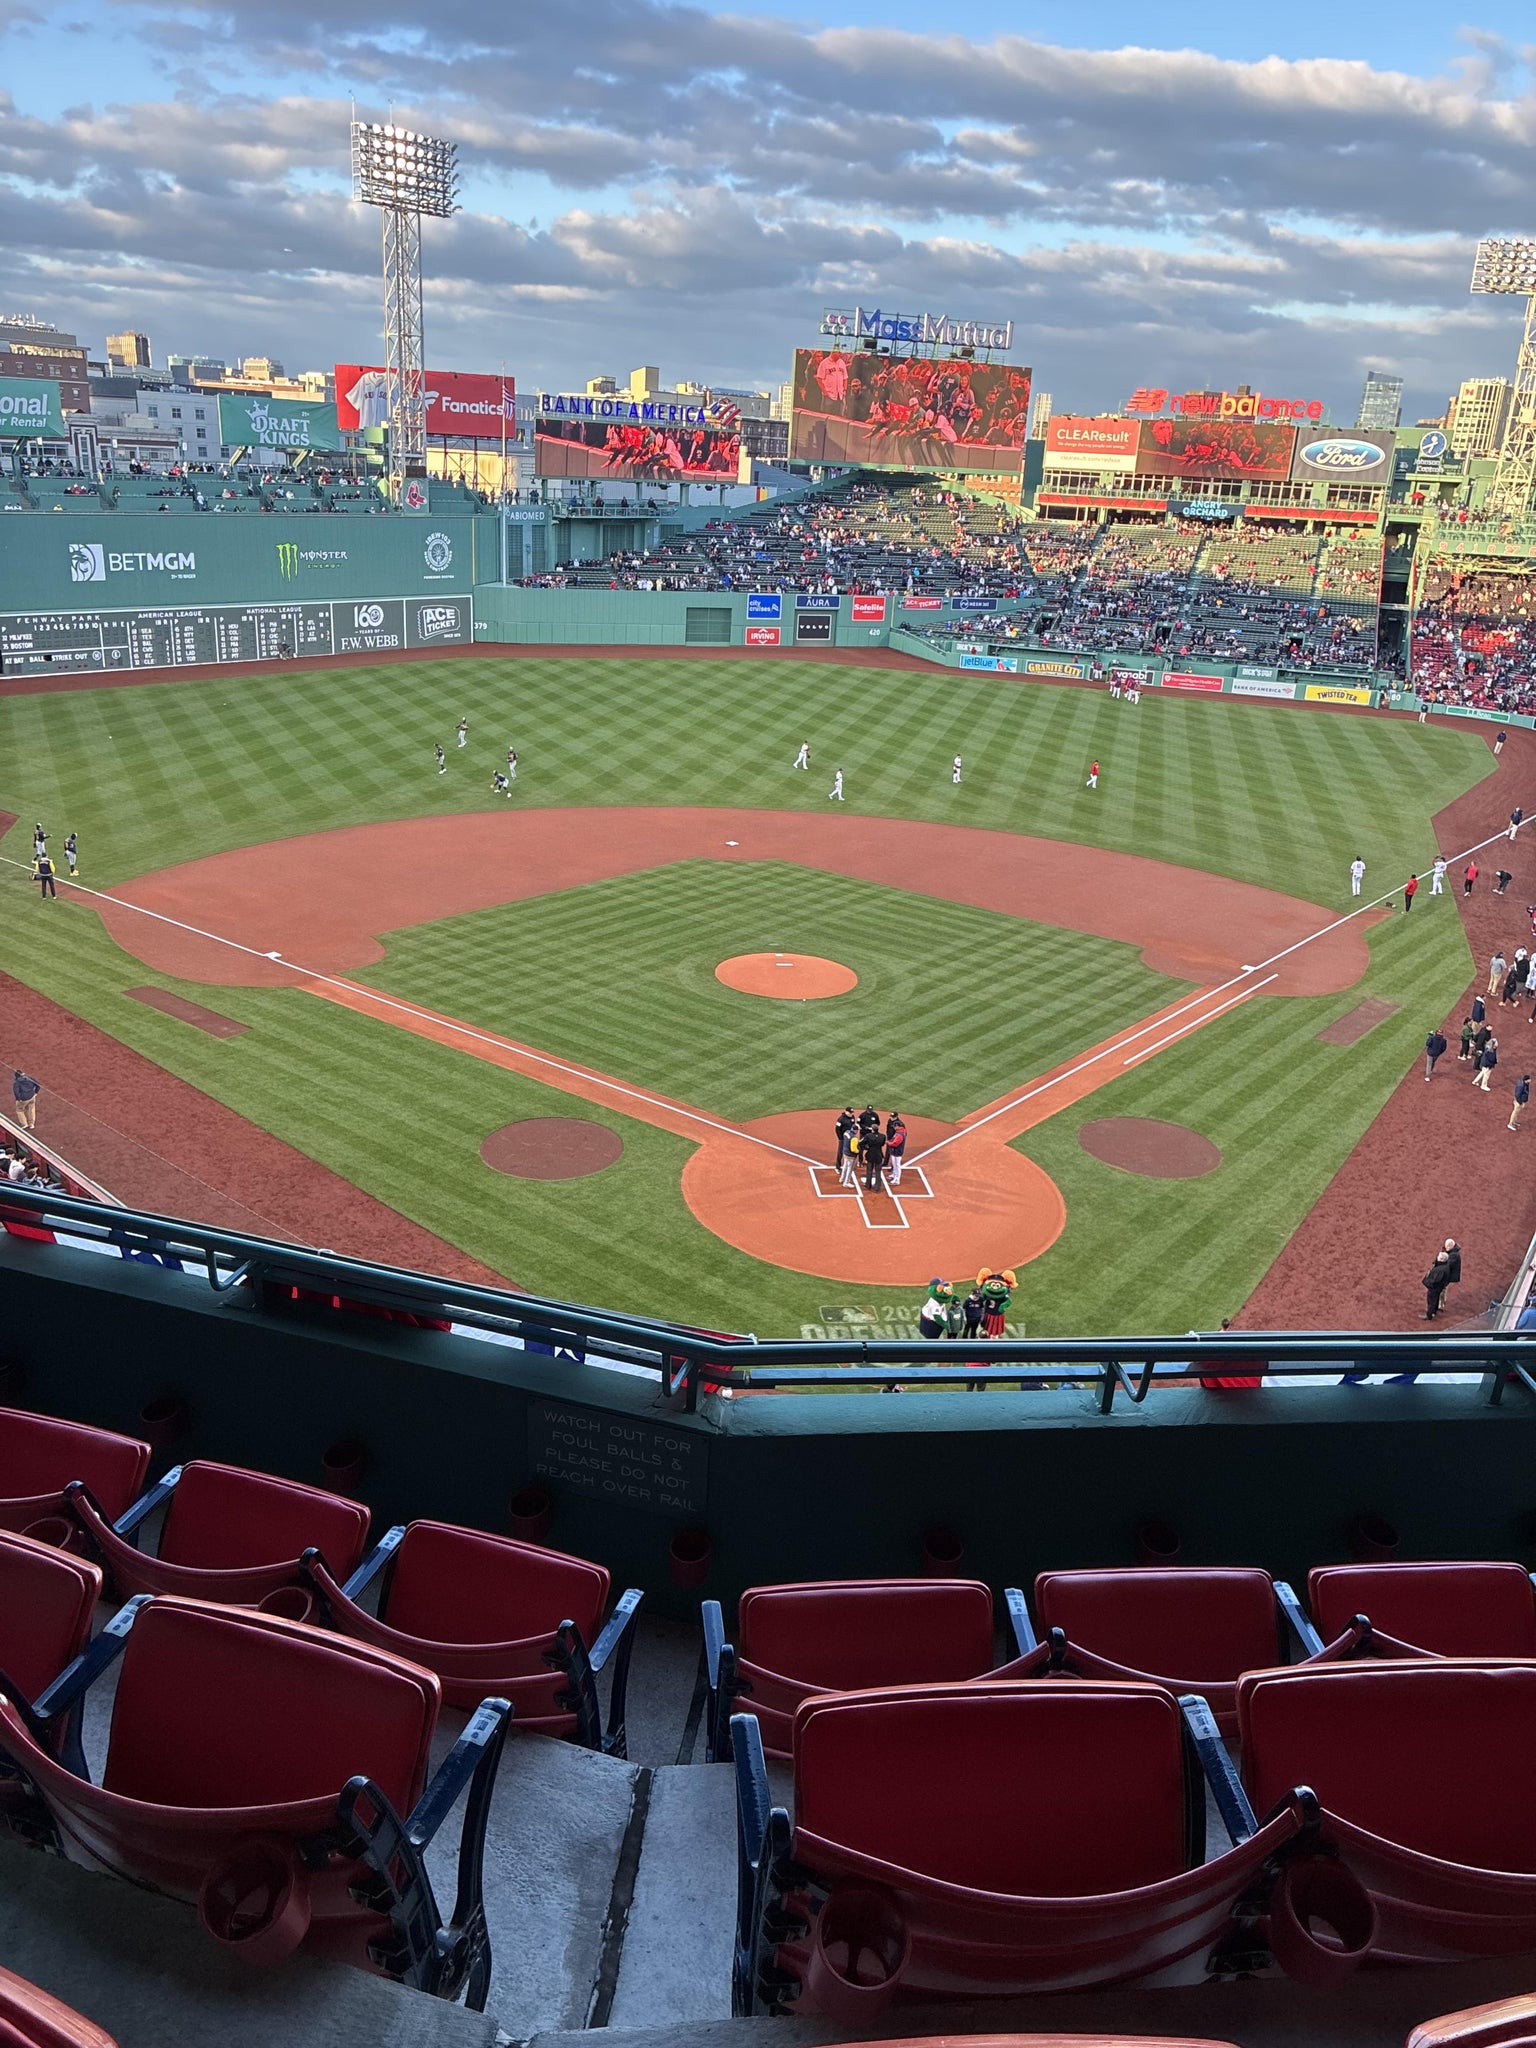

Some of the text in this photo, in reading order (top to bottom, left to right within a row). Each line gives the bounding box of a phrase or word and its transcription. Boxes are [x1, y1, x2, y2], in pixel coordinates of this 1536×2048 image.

[855, 306, 1014, 350] MassMutual
[442, 396, 504, 416] Fanatics
[542, 394, 706, 423] BANK OF AMERICA
[1171, 392, 1324, 419] new balance
[11, 417, 46, 427] Rental
[251, 415, 310, 432] DRAFT
[260, 430, 310, 446] KINGS
[1057, 429, 1129, 442] CLEAResult
[1316, 444, 1368, 466] Ford
[1183, 507, 1228, 517] ORCHARD
[1190, 500, 1222, 509] ANGRY
[510, 511, 544, 520] ABIOMED
[300, 550, 348, 560] MONSTER
[1456, 543, 1464, 552] 4
[1472, 543, 1478, 553] 1
[1504, 545, 1520, 555] 27
[108, 553, 195, 571] BETMGM
[354, 605, 384, 628] 160
[426, 608, 455, 623] ACE
[427, 620, 455, 632] TICKET
[341, 634, 398, 650] F.W. WEBB
[964, 656, 992, 667] jetBlue
[1028, 663, 1062, 672] GRANITE
[1064, 665, 1082, 676] CITY
[1346, 693, 1358, 702] TEA
[989, 1300, 996, 1309] 3
[881, 1305, 921, 1322] 202
[800, 1324, 928, 1340] OPENIN
[544, 1410, 691, 1454] WATCH OUT FOR
[552, 1431, 682, 1471] FOUL BALLS &
[546, 1448, 690, 1490] PLEASE DO NOT
[537, 1463, 697, 1512] REACH OVER RAIL
